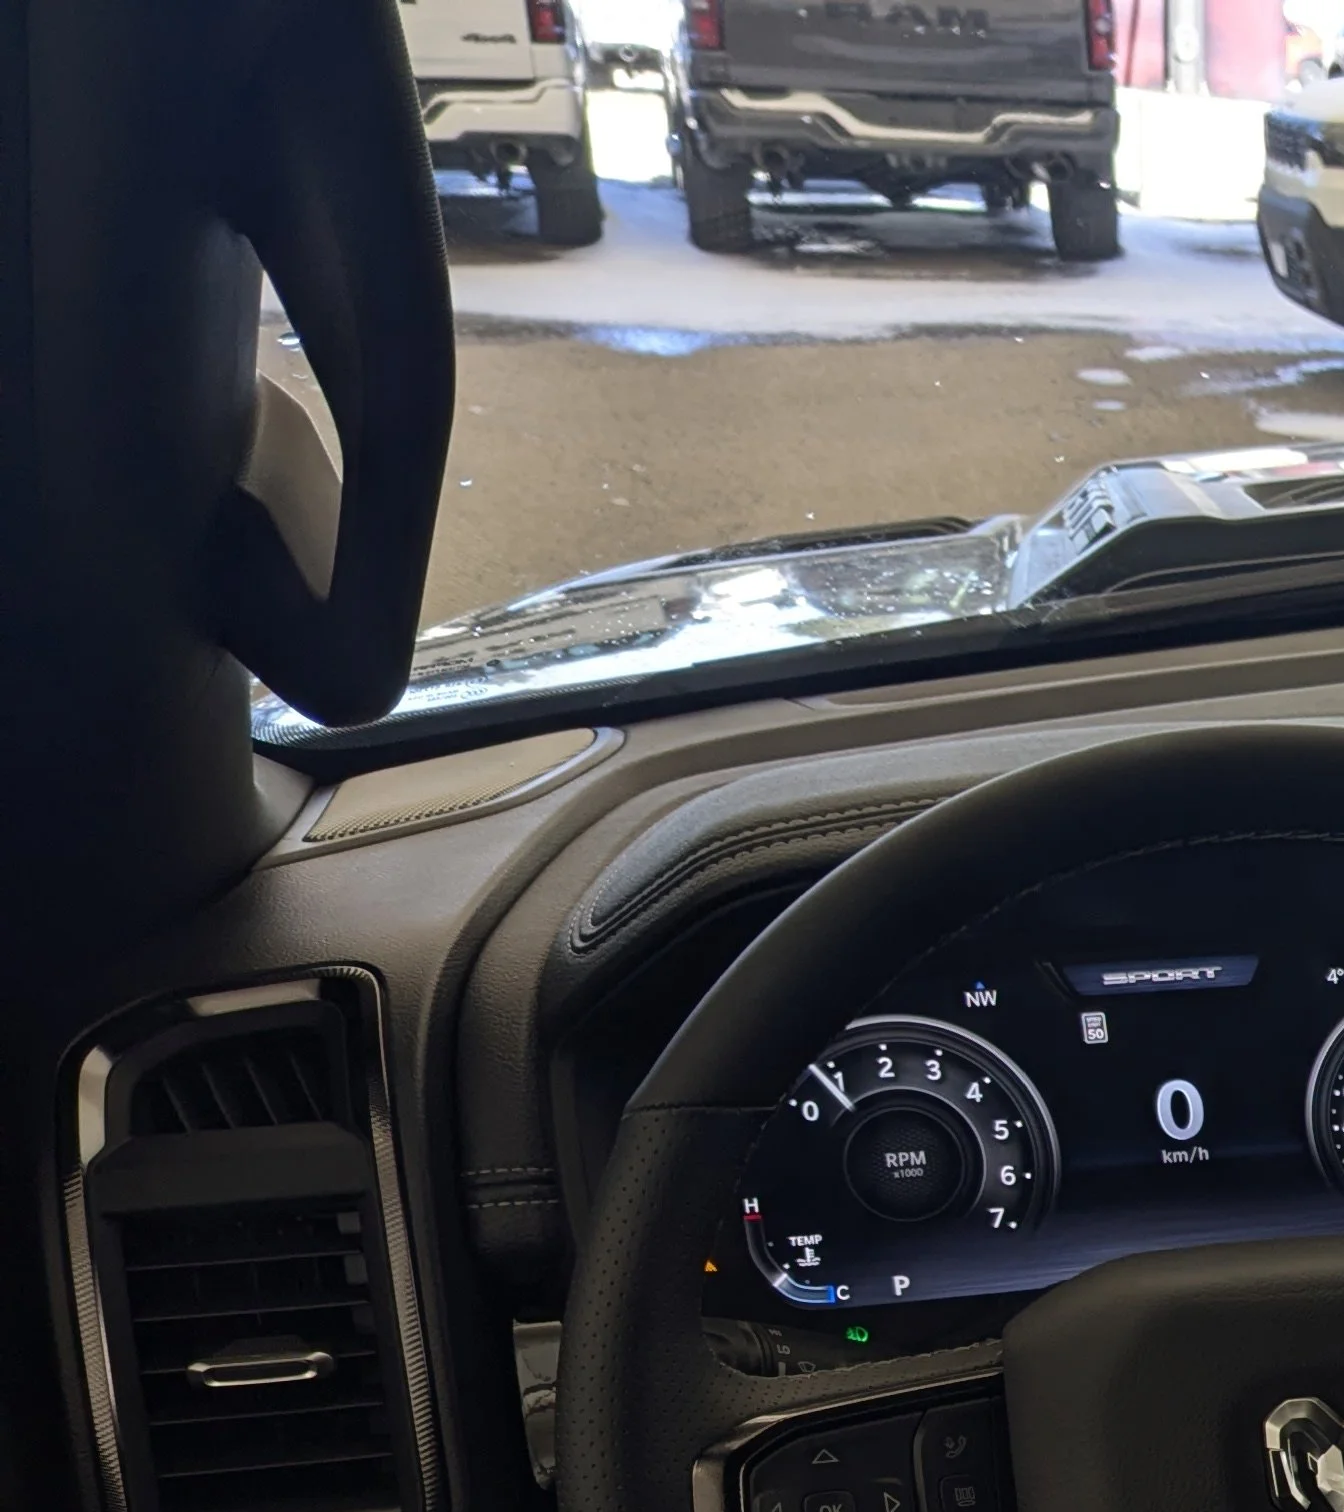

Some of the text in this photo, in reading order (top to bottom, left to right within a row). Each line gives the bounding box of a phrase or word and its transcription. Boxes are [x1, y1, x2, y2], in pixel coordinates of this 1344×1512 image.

[1102, 965, 1223, 986] SPORT
[964, 990, 997, 1008] NW
[1087, 1029, 1104, 1040] 50
[877, 1057, 896, 1079] 2
[925, 1058, 943, 1081] 3
[834, 1070, 846, 1092] 1
[966, 1081, 983, 1103] 4
[801, 1100, 820, 1122] 0
[1155, 1078, 1205, 1141] 0
[993, 1119, 1010, 1140] 5
[884, 1151, 927, 1168] RPM
[1161, 1146, 1210, 1165] km/h
[893, 1167, 924, 1179] x1000
[1000, 1165, 1017, 1186] 6
[743, 1197, 760, 1214] H
[987, 1208, 1005, 1229] 7
[788, 1233, 823, 1247] TEMP
[836, 1285, 851, 1301] C
[891, 1275, 911, 1296] P
